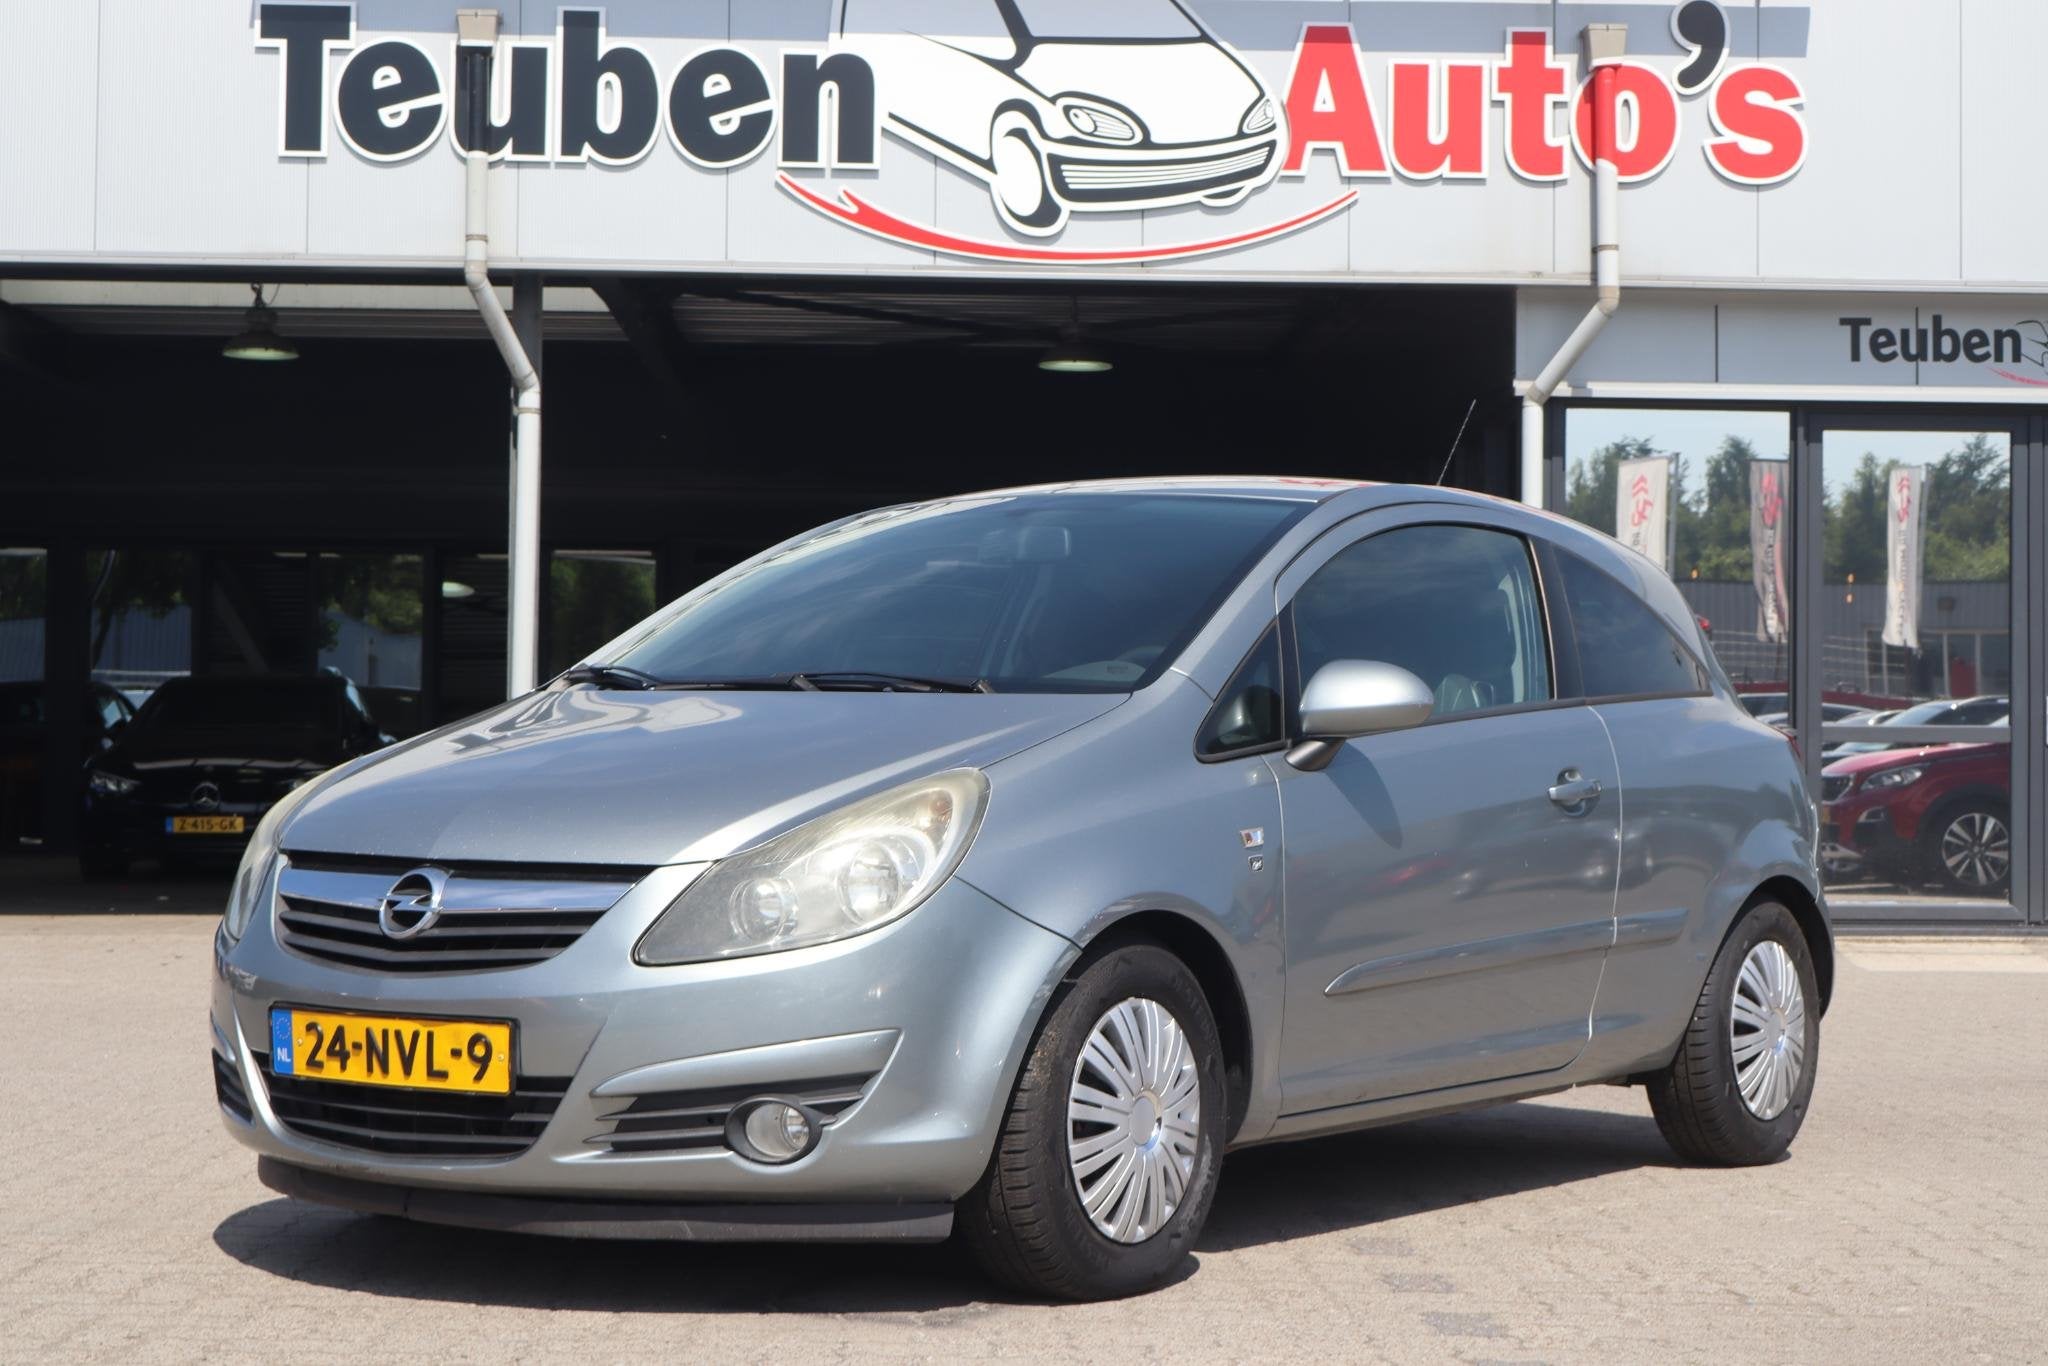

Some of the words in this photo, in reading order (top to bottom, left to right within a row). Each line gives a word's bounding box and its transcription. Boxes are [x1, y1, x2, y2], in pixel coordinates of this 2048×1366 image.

[257, 3, 878, 164] Teuben
[1284, 0, 1806, 180] Auto's
[1839, 314, 2022, 363] Teuben
[277, 1047, 291, 1062] NL
[305, 1021, 493, 1082] 24-NVL-9
